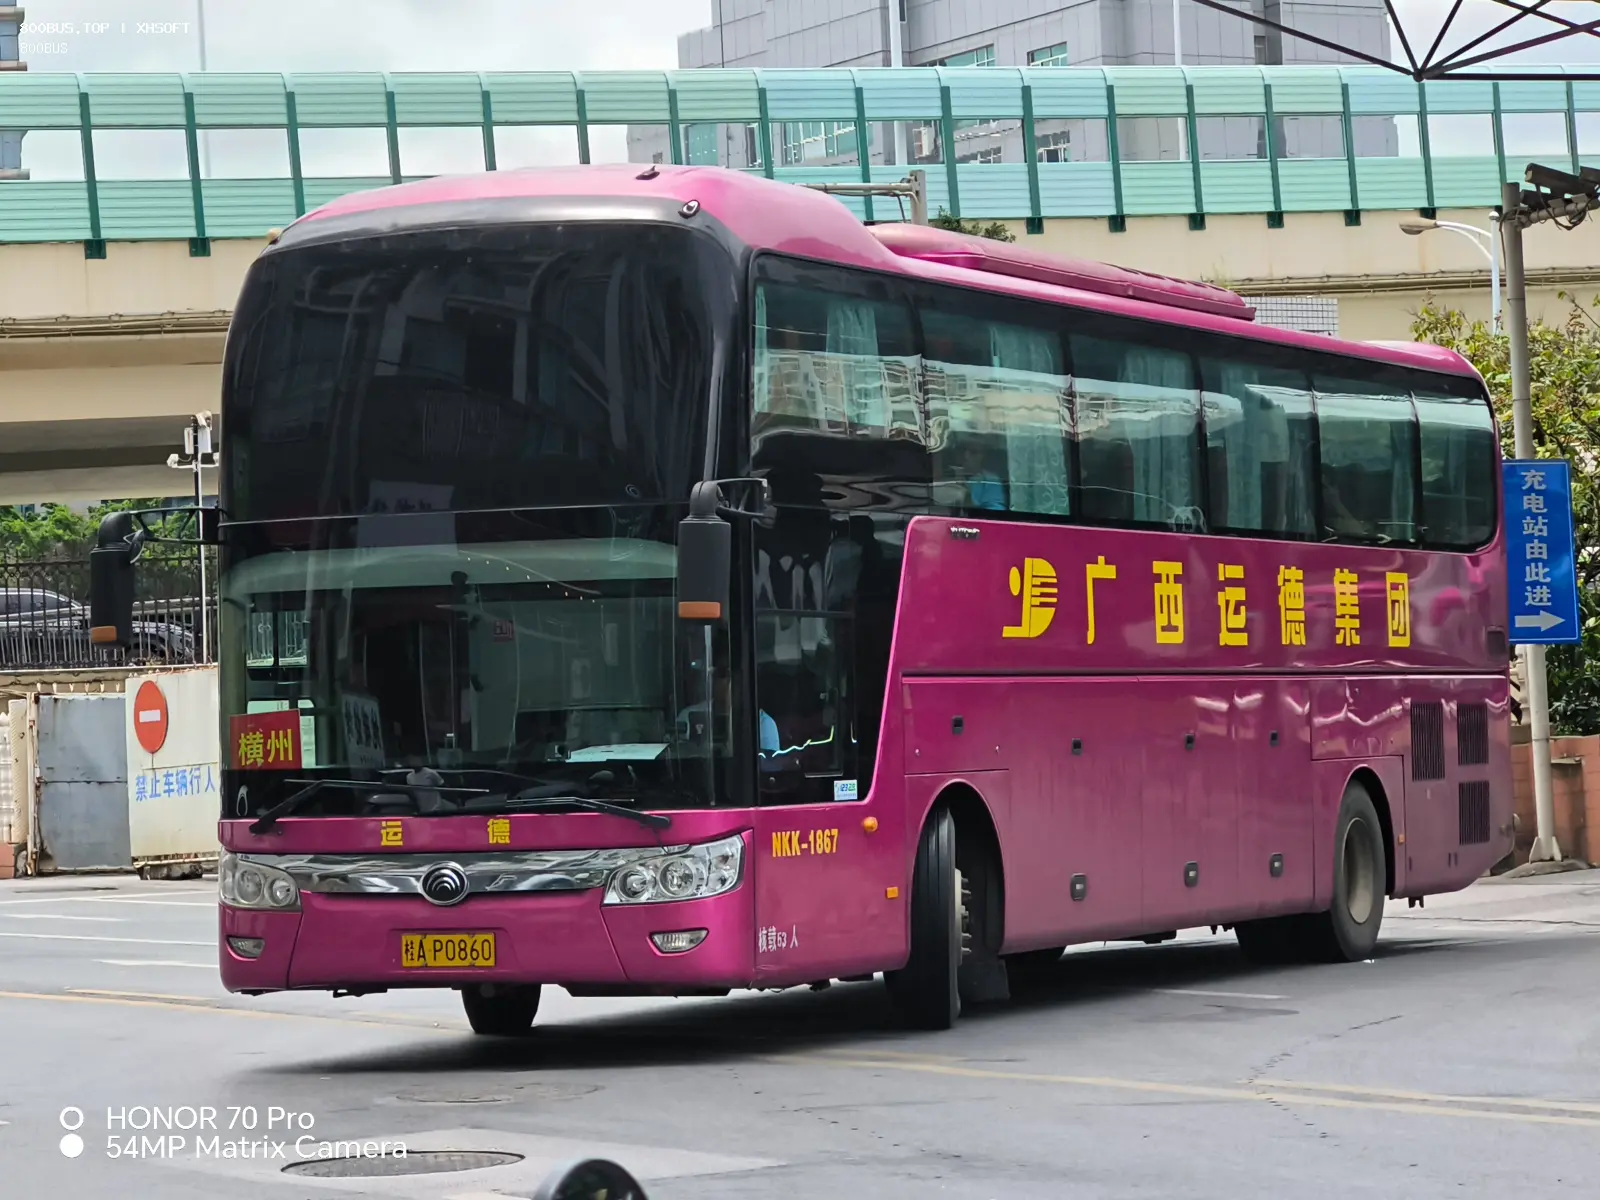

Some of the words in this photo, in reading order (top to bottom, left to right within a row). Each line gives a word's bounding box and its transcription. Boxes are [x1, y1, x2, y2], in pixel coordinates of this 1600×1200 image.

[1521, 469, 1553, 606] 充电站由此进
[1085, 556, 1411, 647] 广西运德集团
[238, 728, 293, 767] 横州
[135, 766, 216, 802] 禁止车辆行人
[771, 828, 839, 858] NKK-1867
